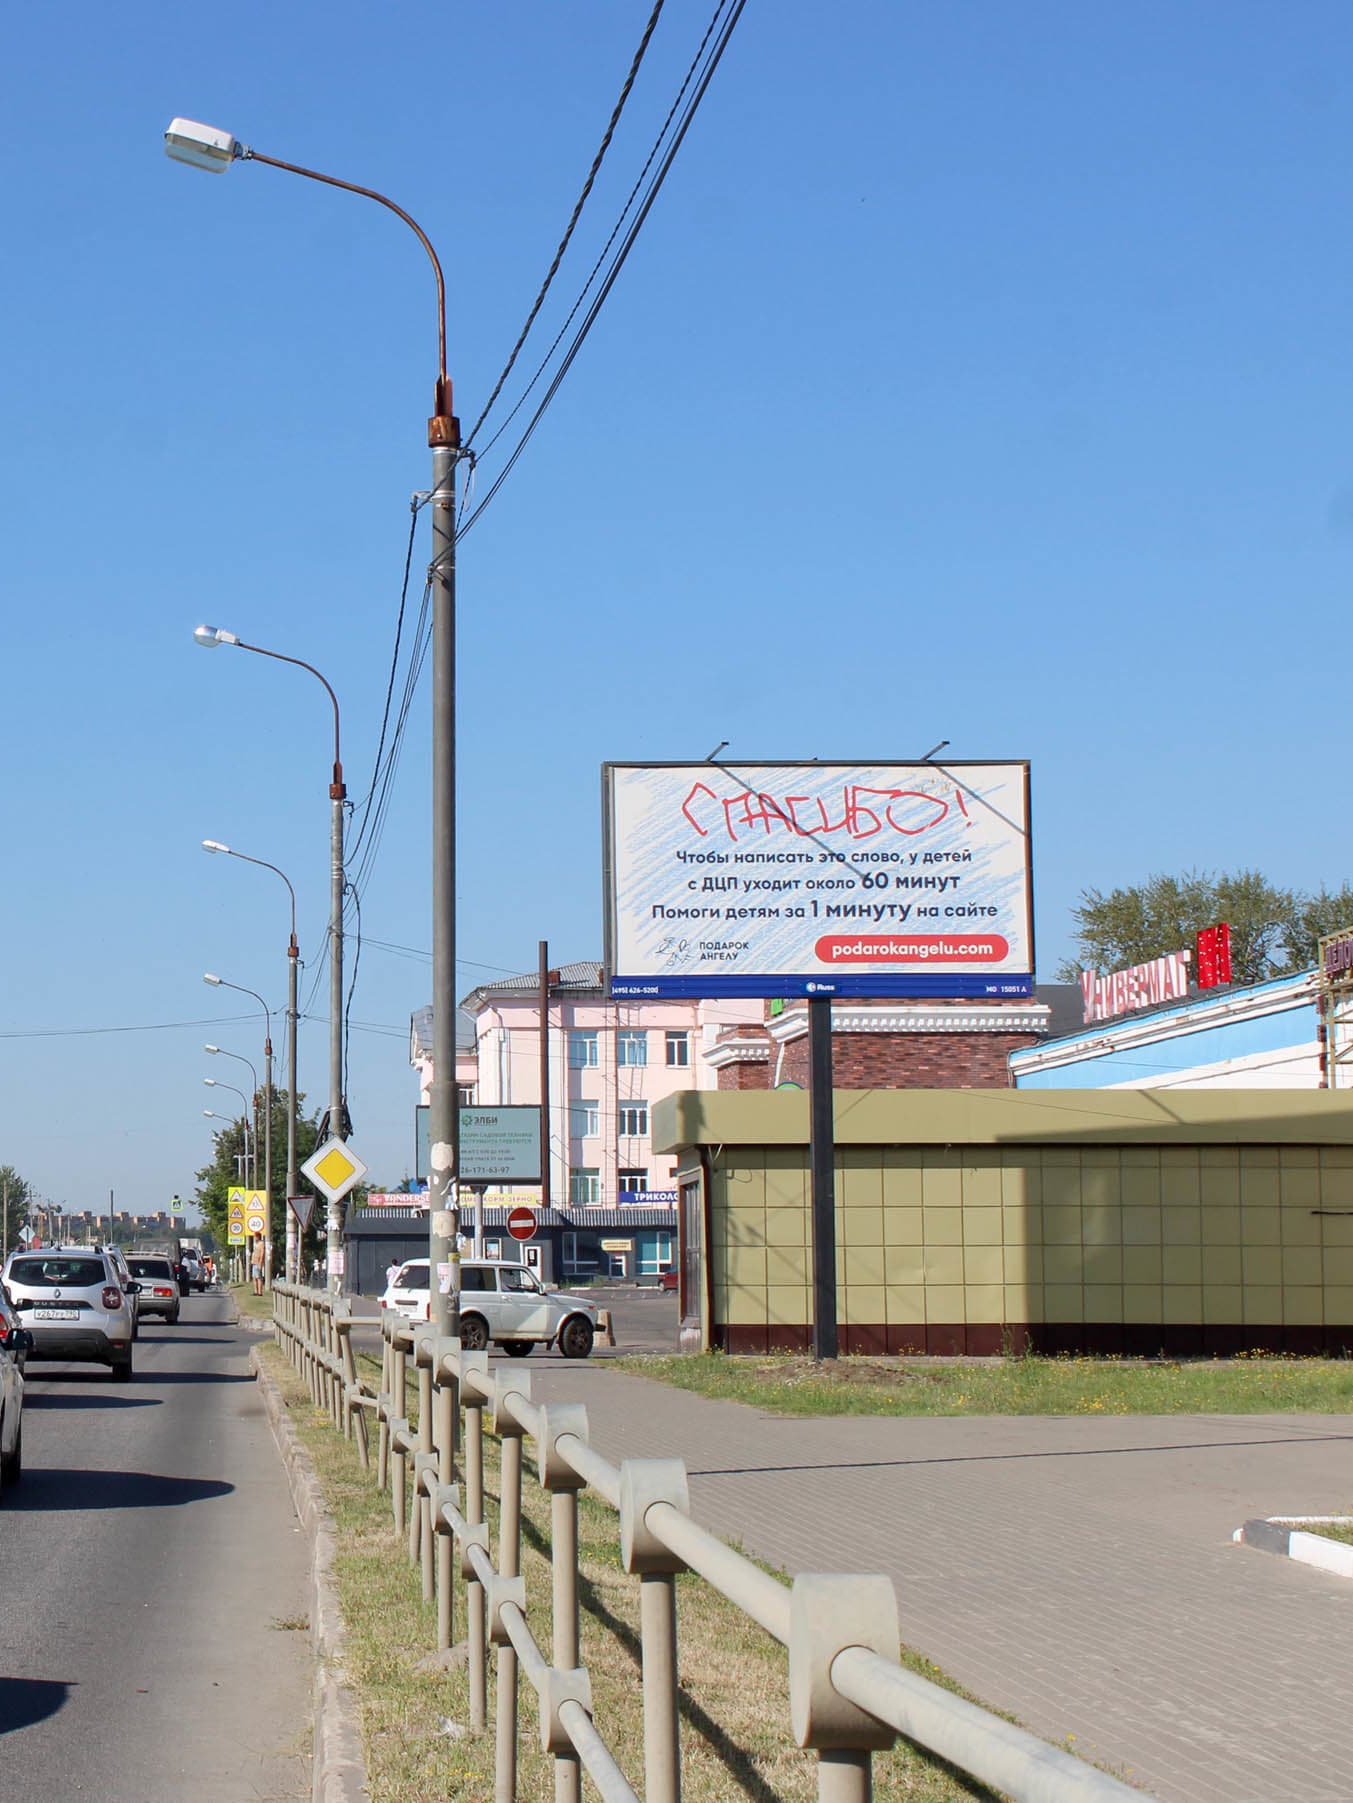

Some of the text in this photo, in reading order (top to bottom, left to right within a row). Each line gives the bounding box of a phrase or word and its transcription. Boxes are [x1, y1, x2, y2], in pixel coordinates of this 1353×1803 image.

[682, 782, 972, 841] СПАСИБО!
[676, 849, 972, 865] Чтобы написать это слово, у детей
[687, 871, 960, 893] с ДЦП уходит около 60 минут
[652, 899, 998, 922] Помоги детям за 1 минуту на сайте
[699, 941, 749, 950] ПОДАРОК
[832, 940, 993, 959] podarokangelu.com
[700, 952, 738, 961] АНГЕЛУ
[1080, 950, 1191, 1024] УНИВЕРМАГ
[634, 1192, 679, 1201] ТРИКОЛО
